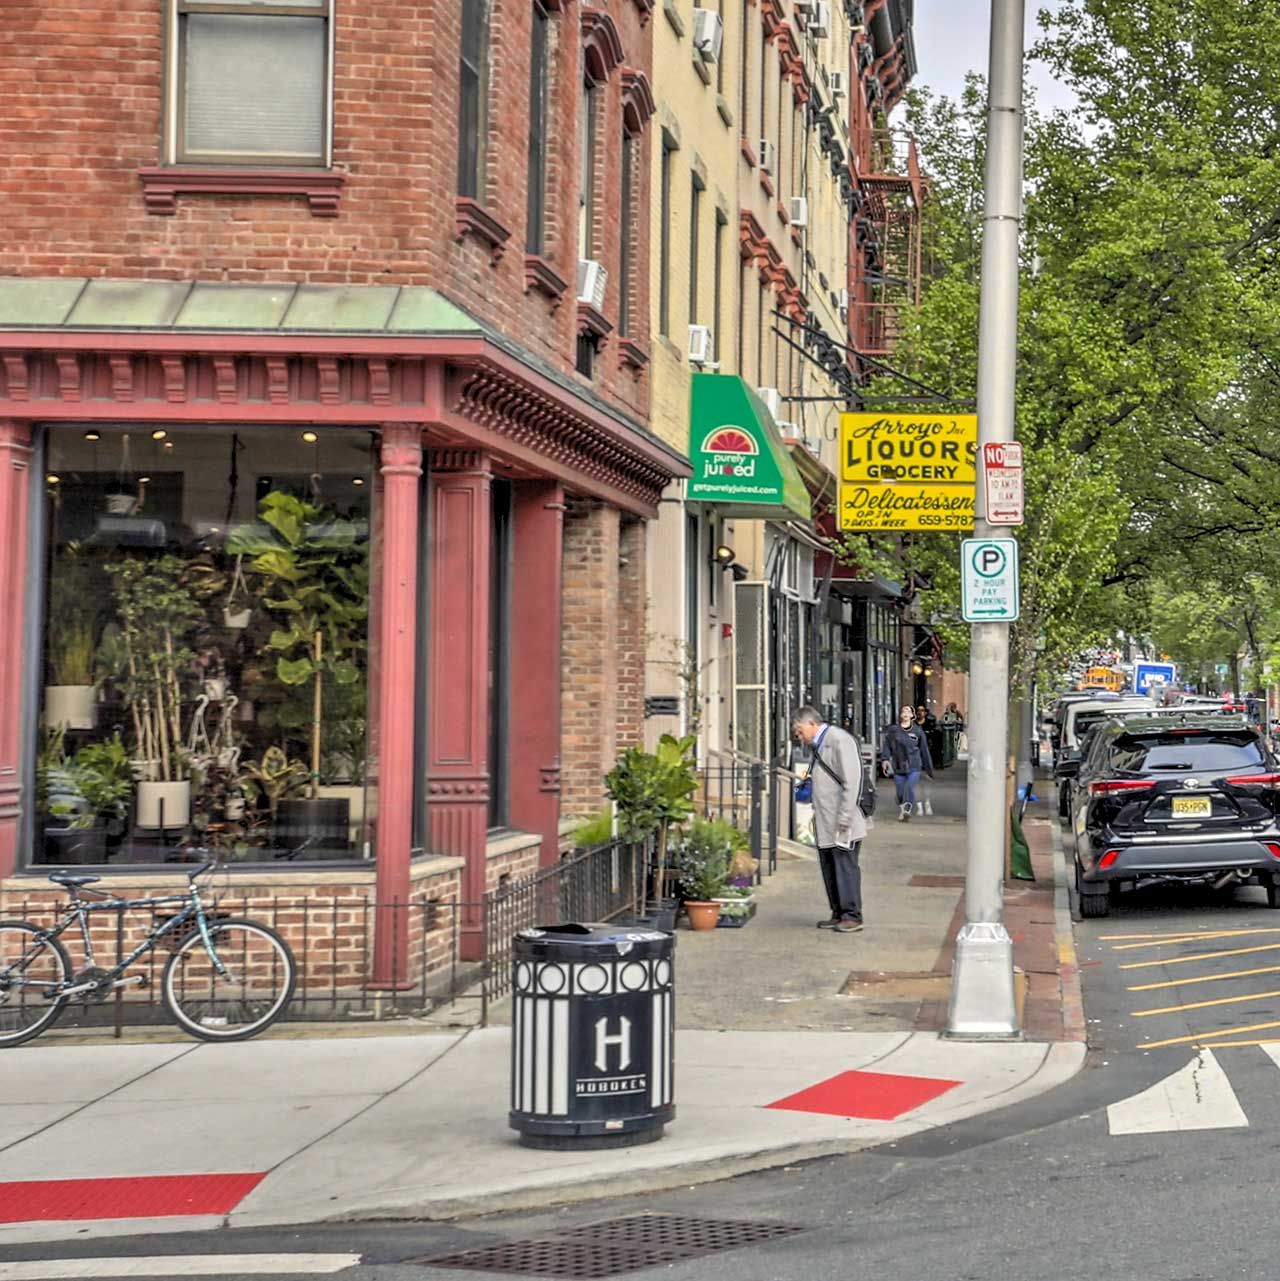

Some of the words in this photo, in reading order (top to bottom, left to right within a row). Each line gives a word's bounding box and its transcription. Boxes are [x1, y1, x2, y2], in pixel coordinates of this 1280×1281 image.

[853, 419, 943, 441] Arroyo
[714, 454, 746, 465] purely
[847, 439, 977, 467] LIQUORS
[986, 447, 1003, 464] NO
[867, 464, 959, 480] GROCERY
[693, 483, 778, 495] getpurelyjuiced.com
[918, 515, 976, 526] 659-5787
[983, 550, 1000, 571] P
[983, 579, 1005, 587] HOUR
[974, 598, 1007, 606] PARKING
[595, 1016, 631, 1072] H
[576, 1079, 647, 1094] HOBOKEN
